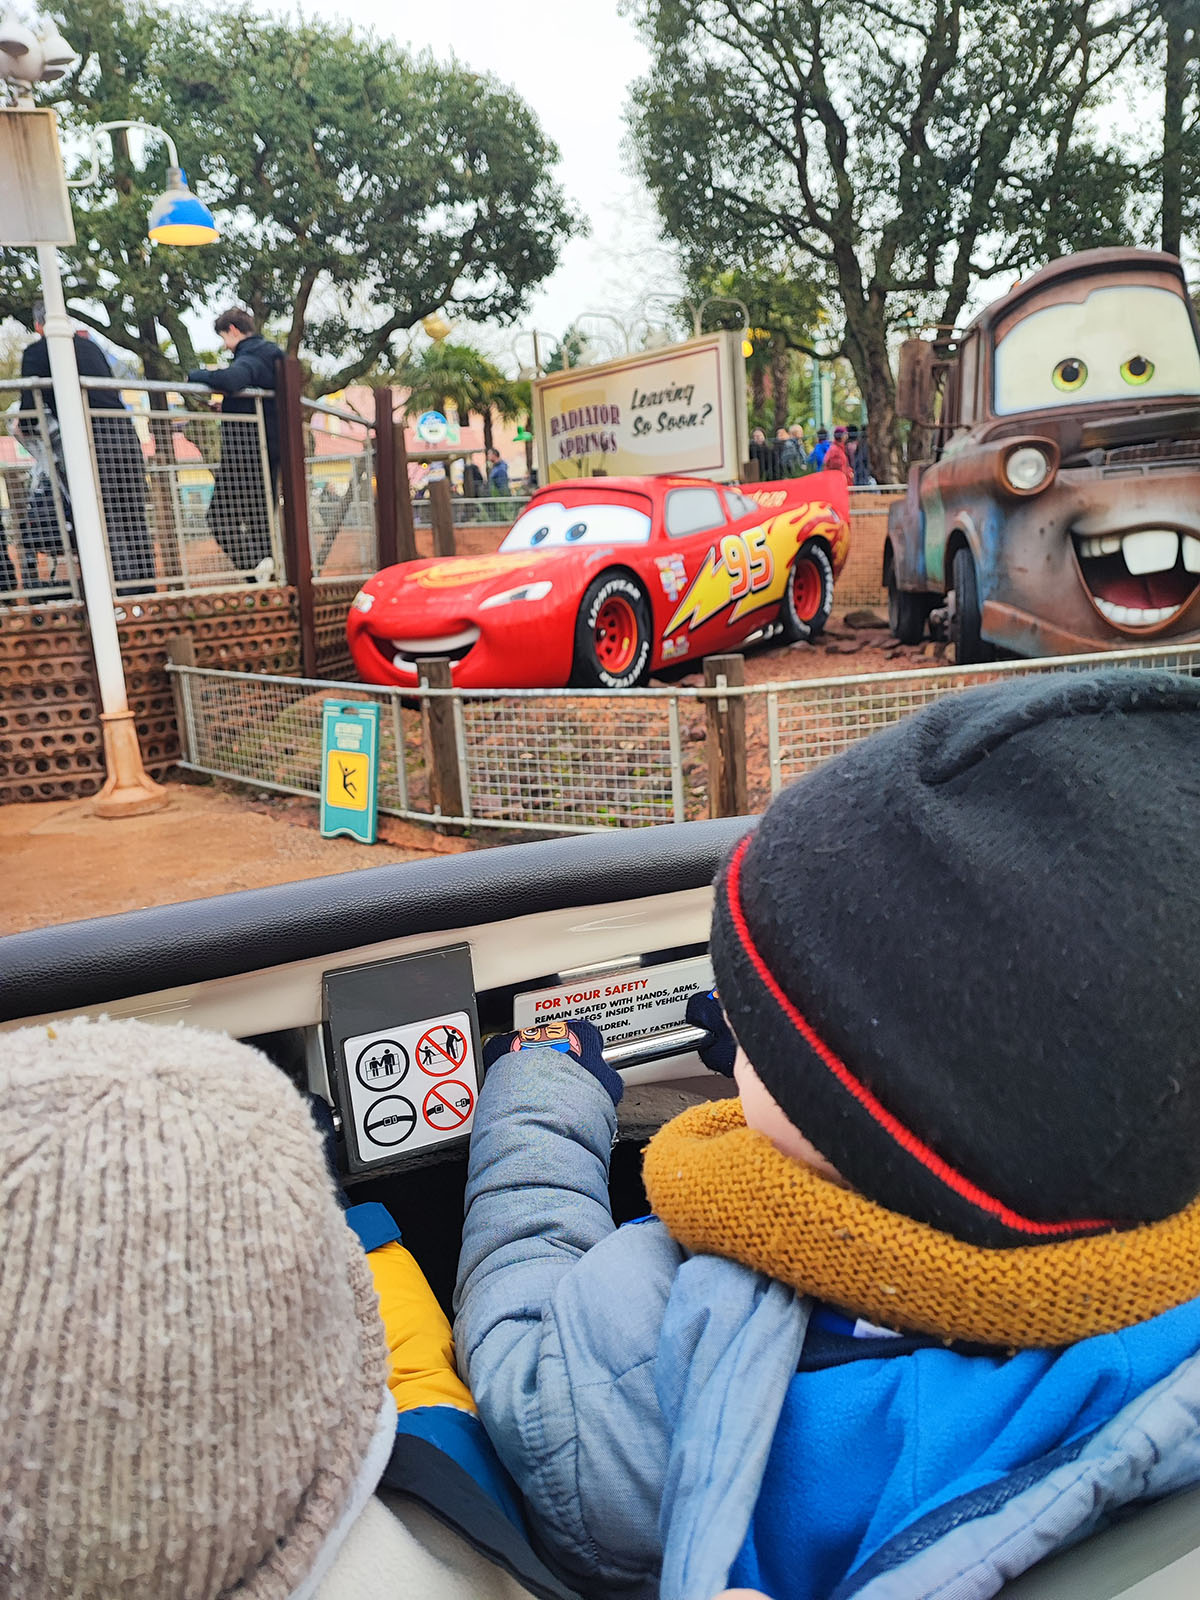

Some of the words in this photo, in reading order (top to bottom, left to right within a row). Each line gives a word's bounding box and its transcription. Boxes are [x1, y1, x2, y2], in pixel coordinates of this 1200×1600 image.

[631, 381, 695, 410] Leaving
[551, 404, 620, 437] RADIATOR
[632, 416, 653, 437] So
[657, 403, 713, 433] Soon?
[560, 431, 617, 459] SPRINGS
[720, 526, 774, 601] 95
[535, 997, 562, 1012] FOR
[565, 989, 601, 1004] YOUR
[605, 978, 649, 997] SAFETY
[535, 1010, 572, 1024] REMAIN
[574, 1002, 607, 1016] SEATED
[609, 997, 633, 1008] WITH
[636, 988, 671, 1002] HANDS,
[672, 982, 700, 995] ARMS,
[605, 1005, 635, 1018] INSIDE
[637, 1001, 653, 1011] THE
